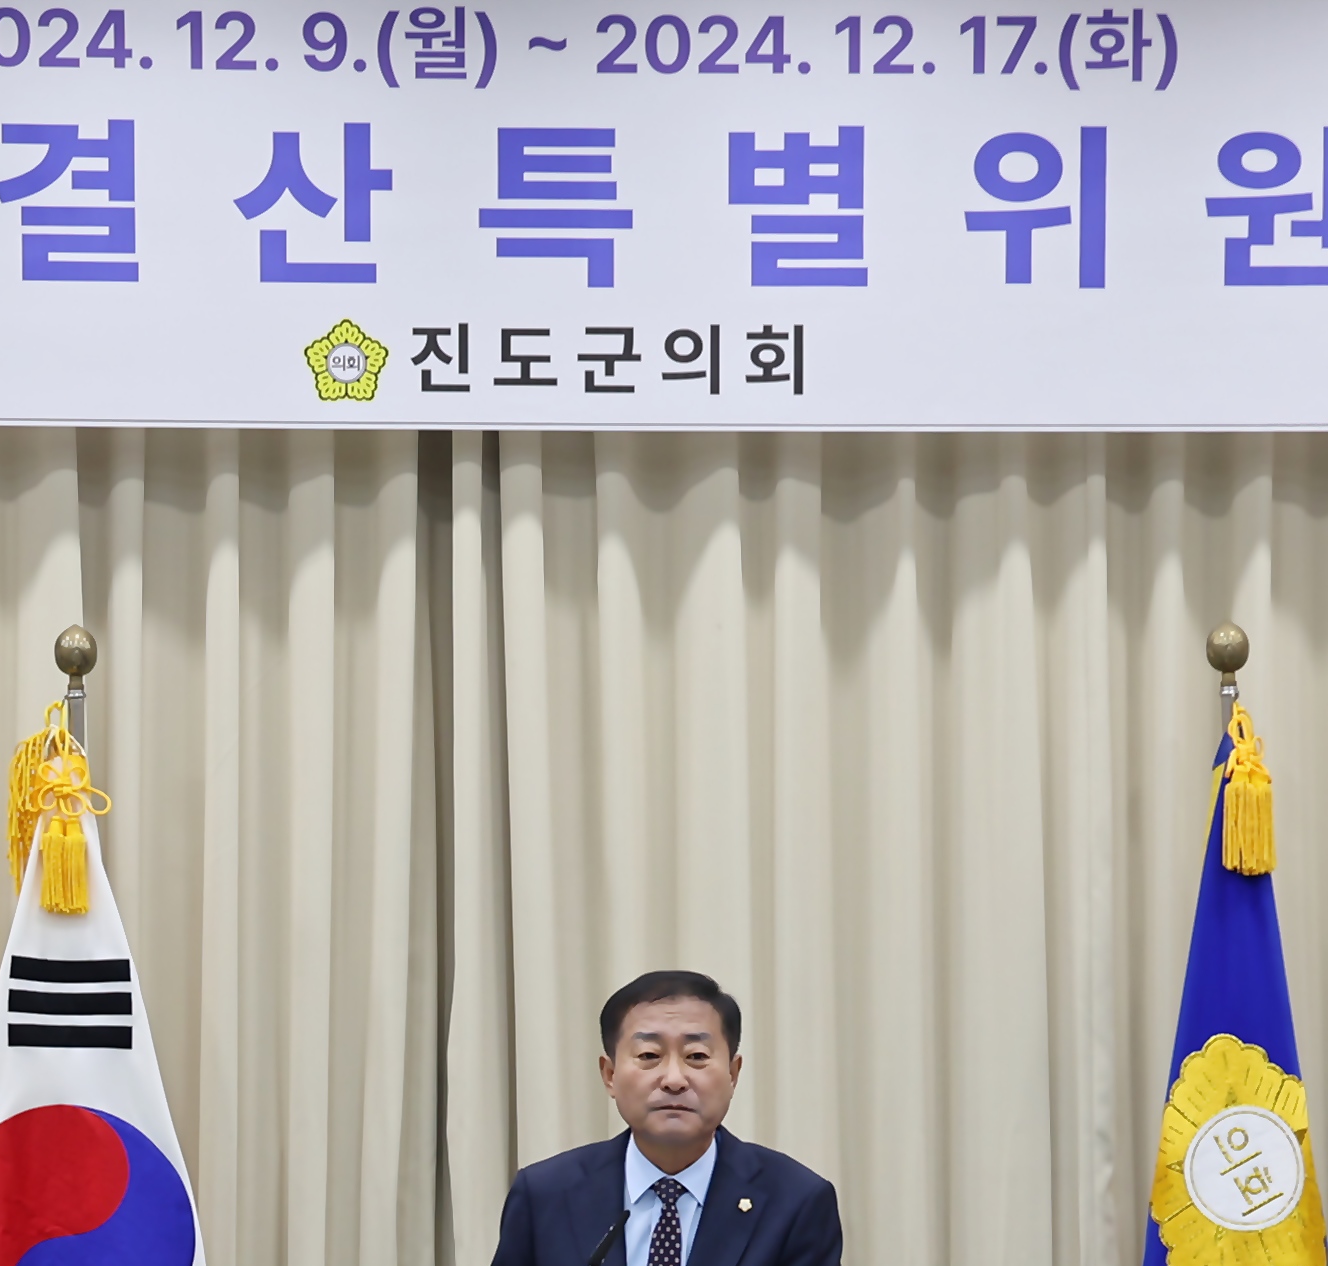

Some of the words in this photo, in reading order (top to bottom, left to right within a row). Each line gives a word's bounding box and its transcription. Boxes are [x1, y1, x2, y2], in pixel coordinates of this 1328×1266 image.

[176, 11, 279, 73] 12.
[302, 7, 498, 90] 9.(월)
[595, 13, 811, 77] 2024.
[835, 14, 936, 77] 12.
[959, 8, 1178, 91] 17.(화)
[331, 354, 361, 372] 의회
[410, 322, 804, 396] 진도군의회
[1212, 1126, 1285, 1217] 의회
